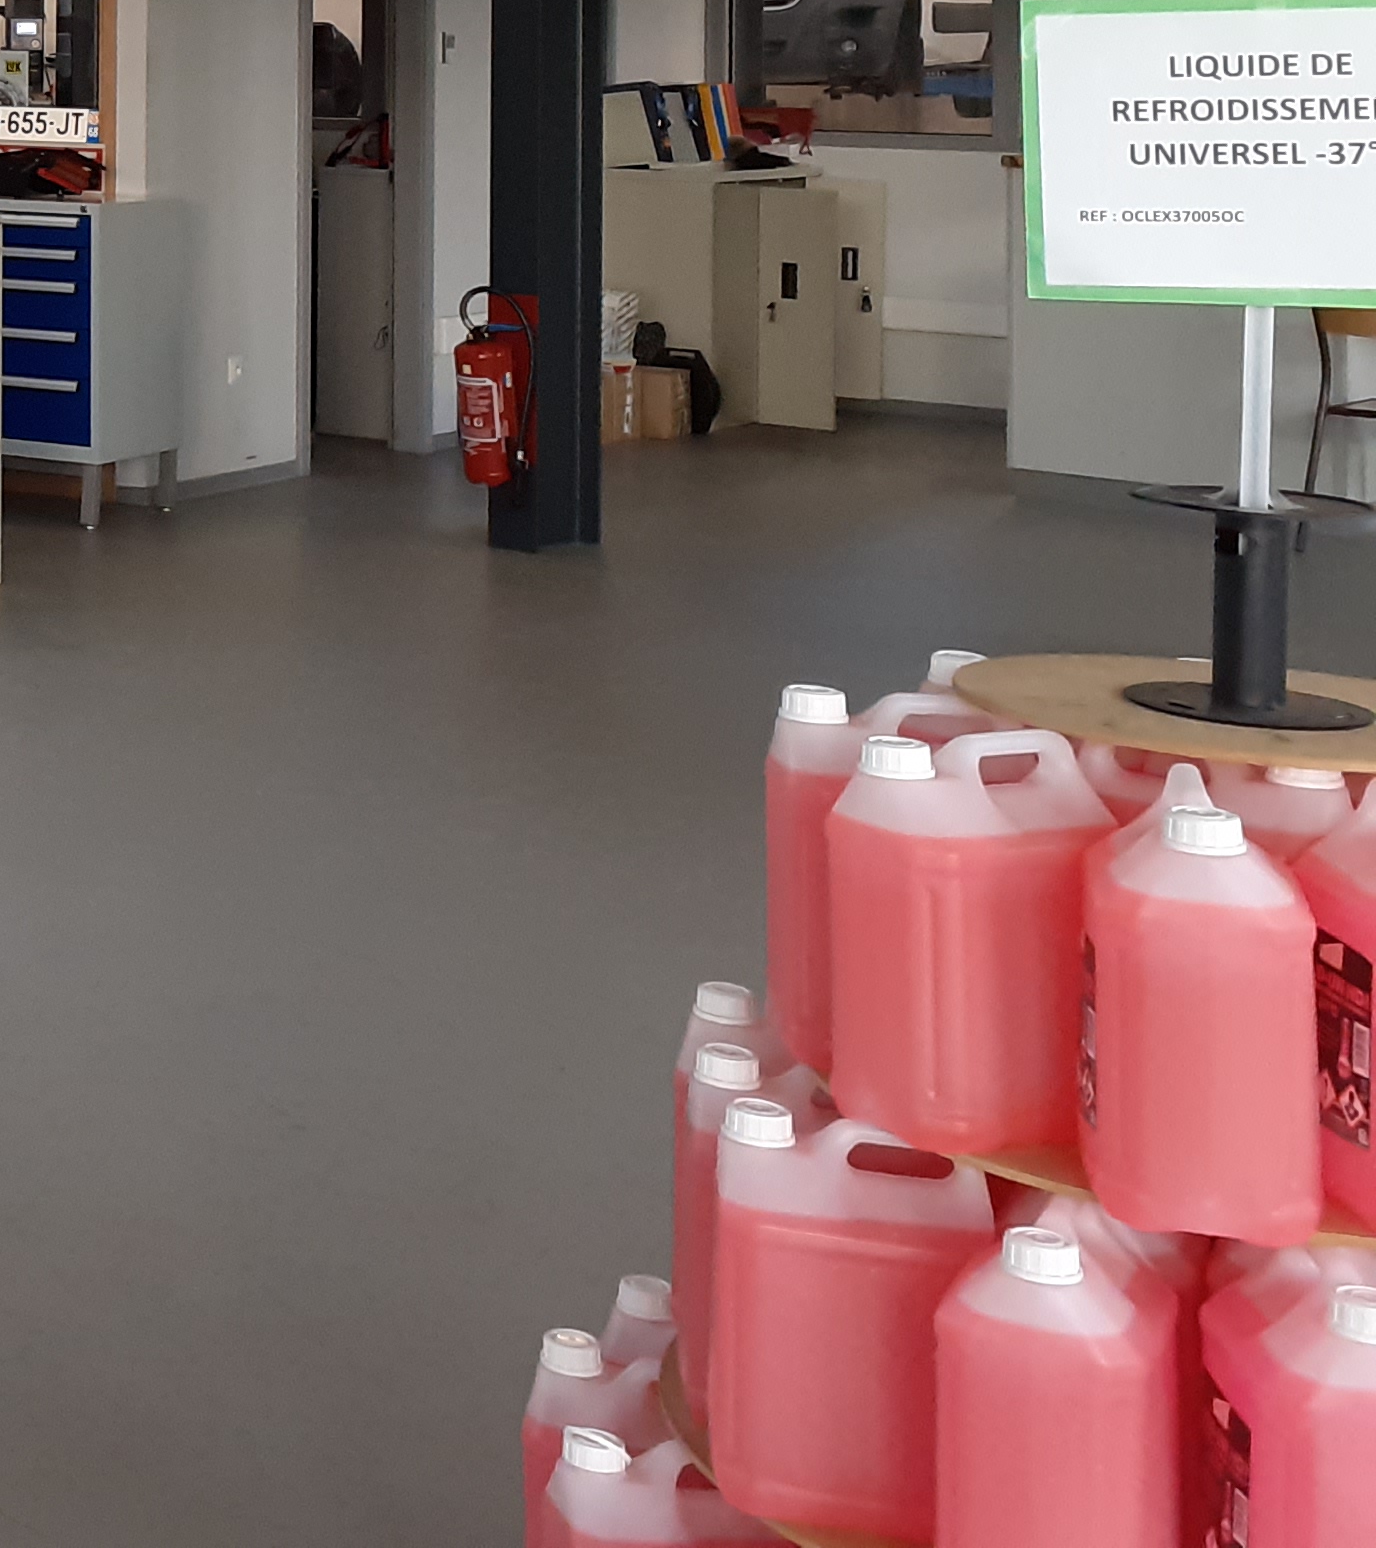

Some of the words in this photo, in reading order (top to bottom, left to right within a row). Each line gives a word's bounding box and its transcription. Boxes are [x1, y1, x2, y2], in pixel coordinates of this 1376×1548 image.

[1169, 54, 1299, 80] LIQUIDE
[1311, 53, 1352, 76] DE
[1113, 98, 1376, 121] REFROIDISSEME
[1130, 143, 1306, 165] UNIVERSEL
[1080, 210, 1108, 222] REF
